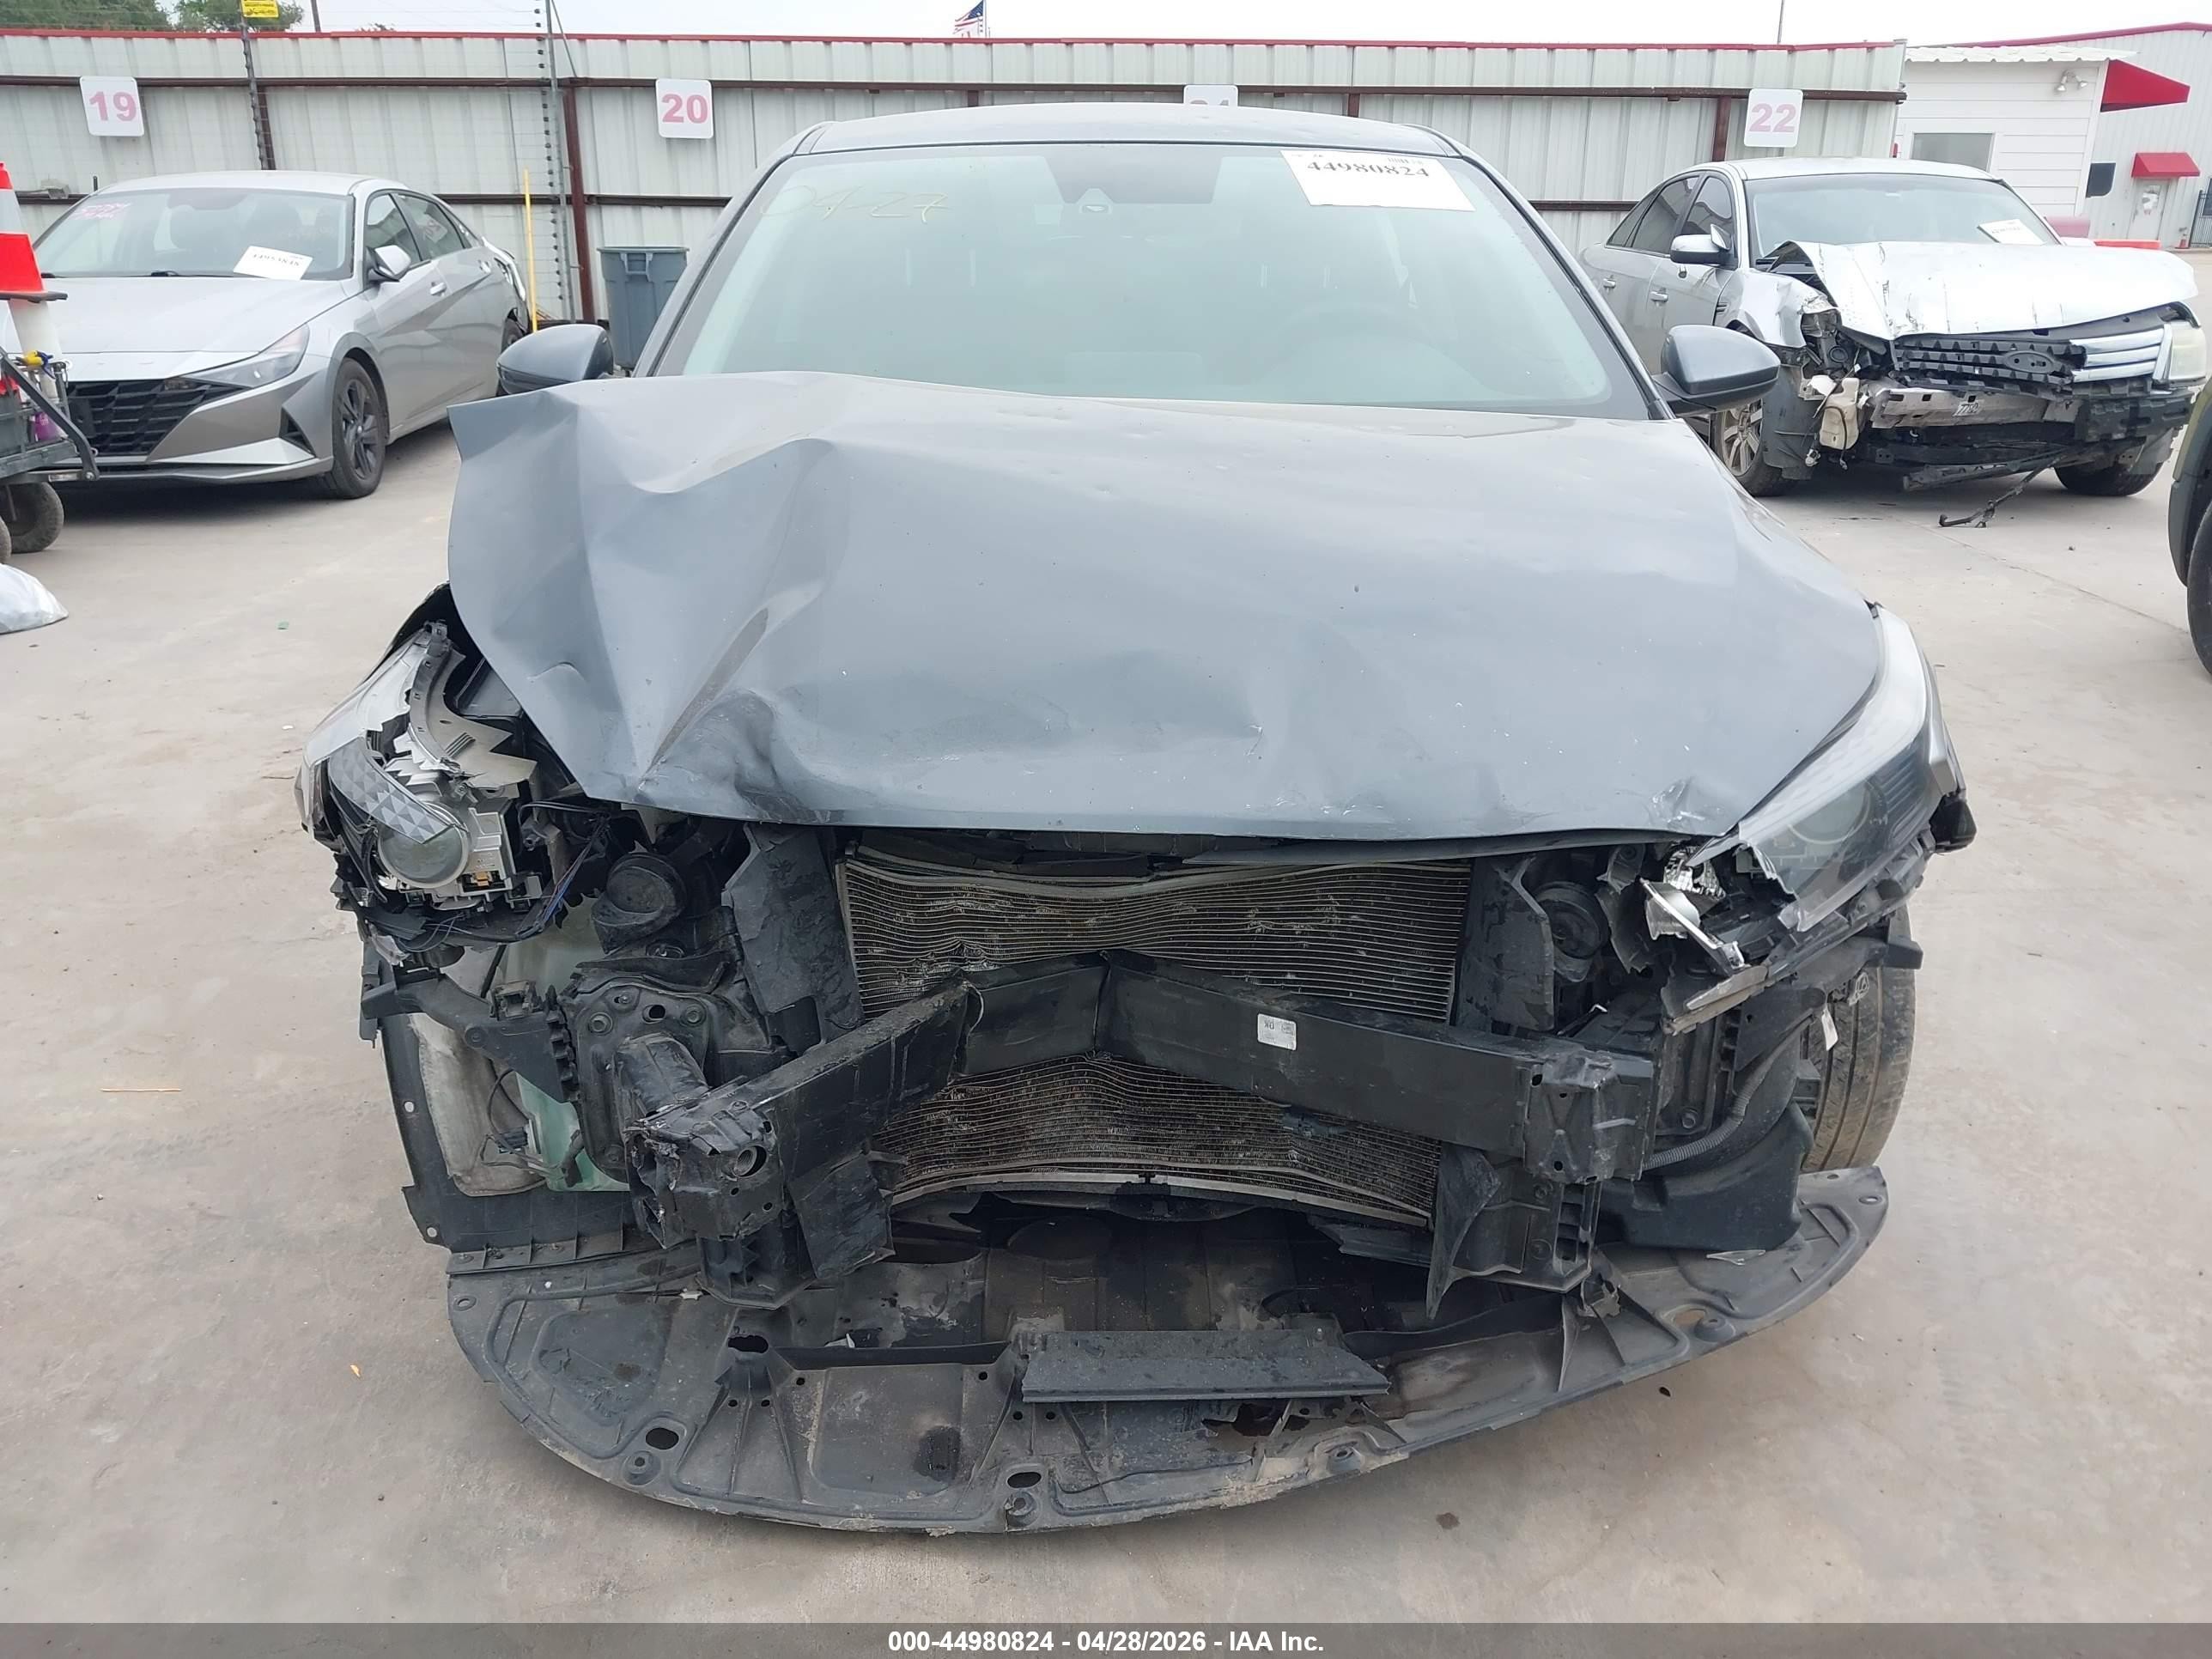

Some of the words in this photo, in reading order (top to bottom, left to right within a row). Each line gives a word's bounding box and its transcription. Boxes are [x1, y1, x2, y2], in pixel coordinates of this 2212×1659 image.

[89, 91, 137, 122] 19
[661, 94, 708, 124] 20
[1749, 103, 1796, 132] 22
[1307, 161, 1430, 177] 44980824
